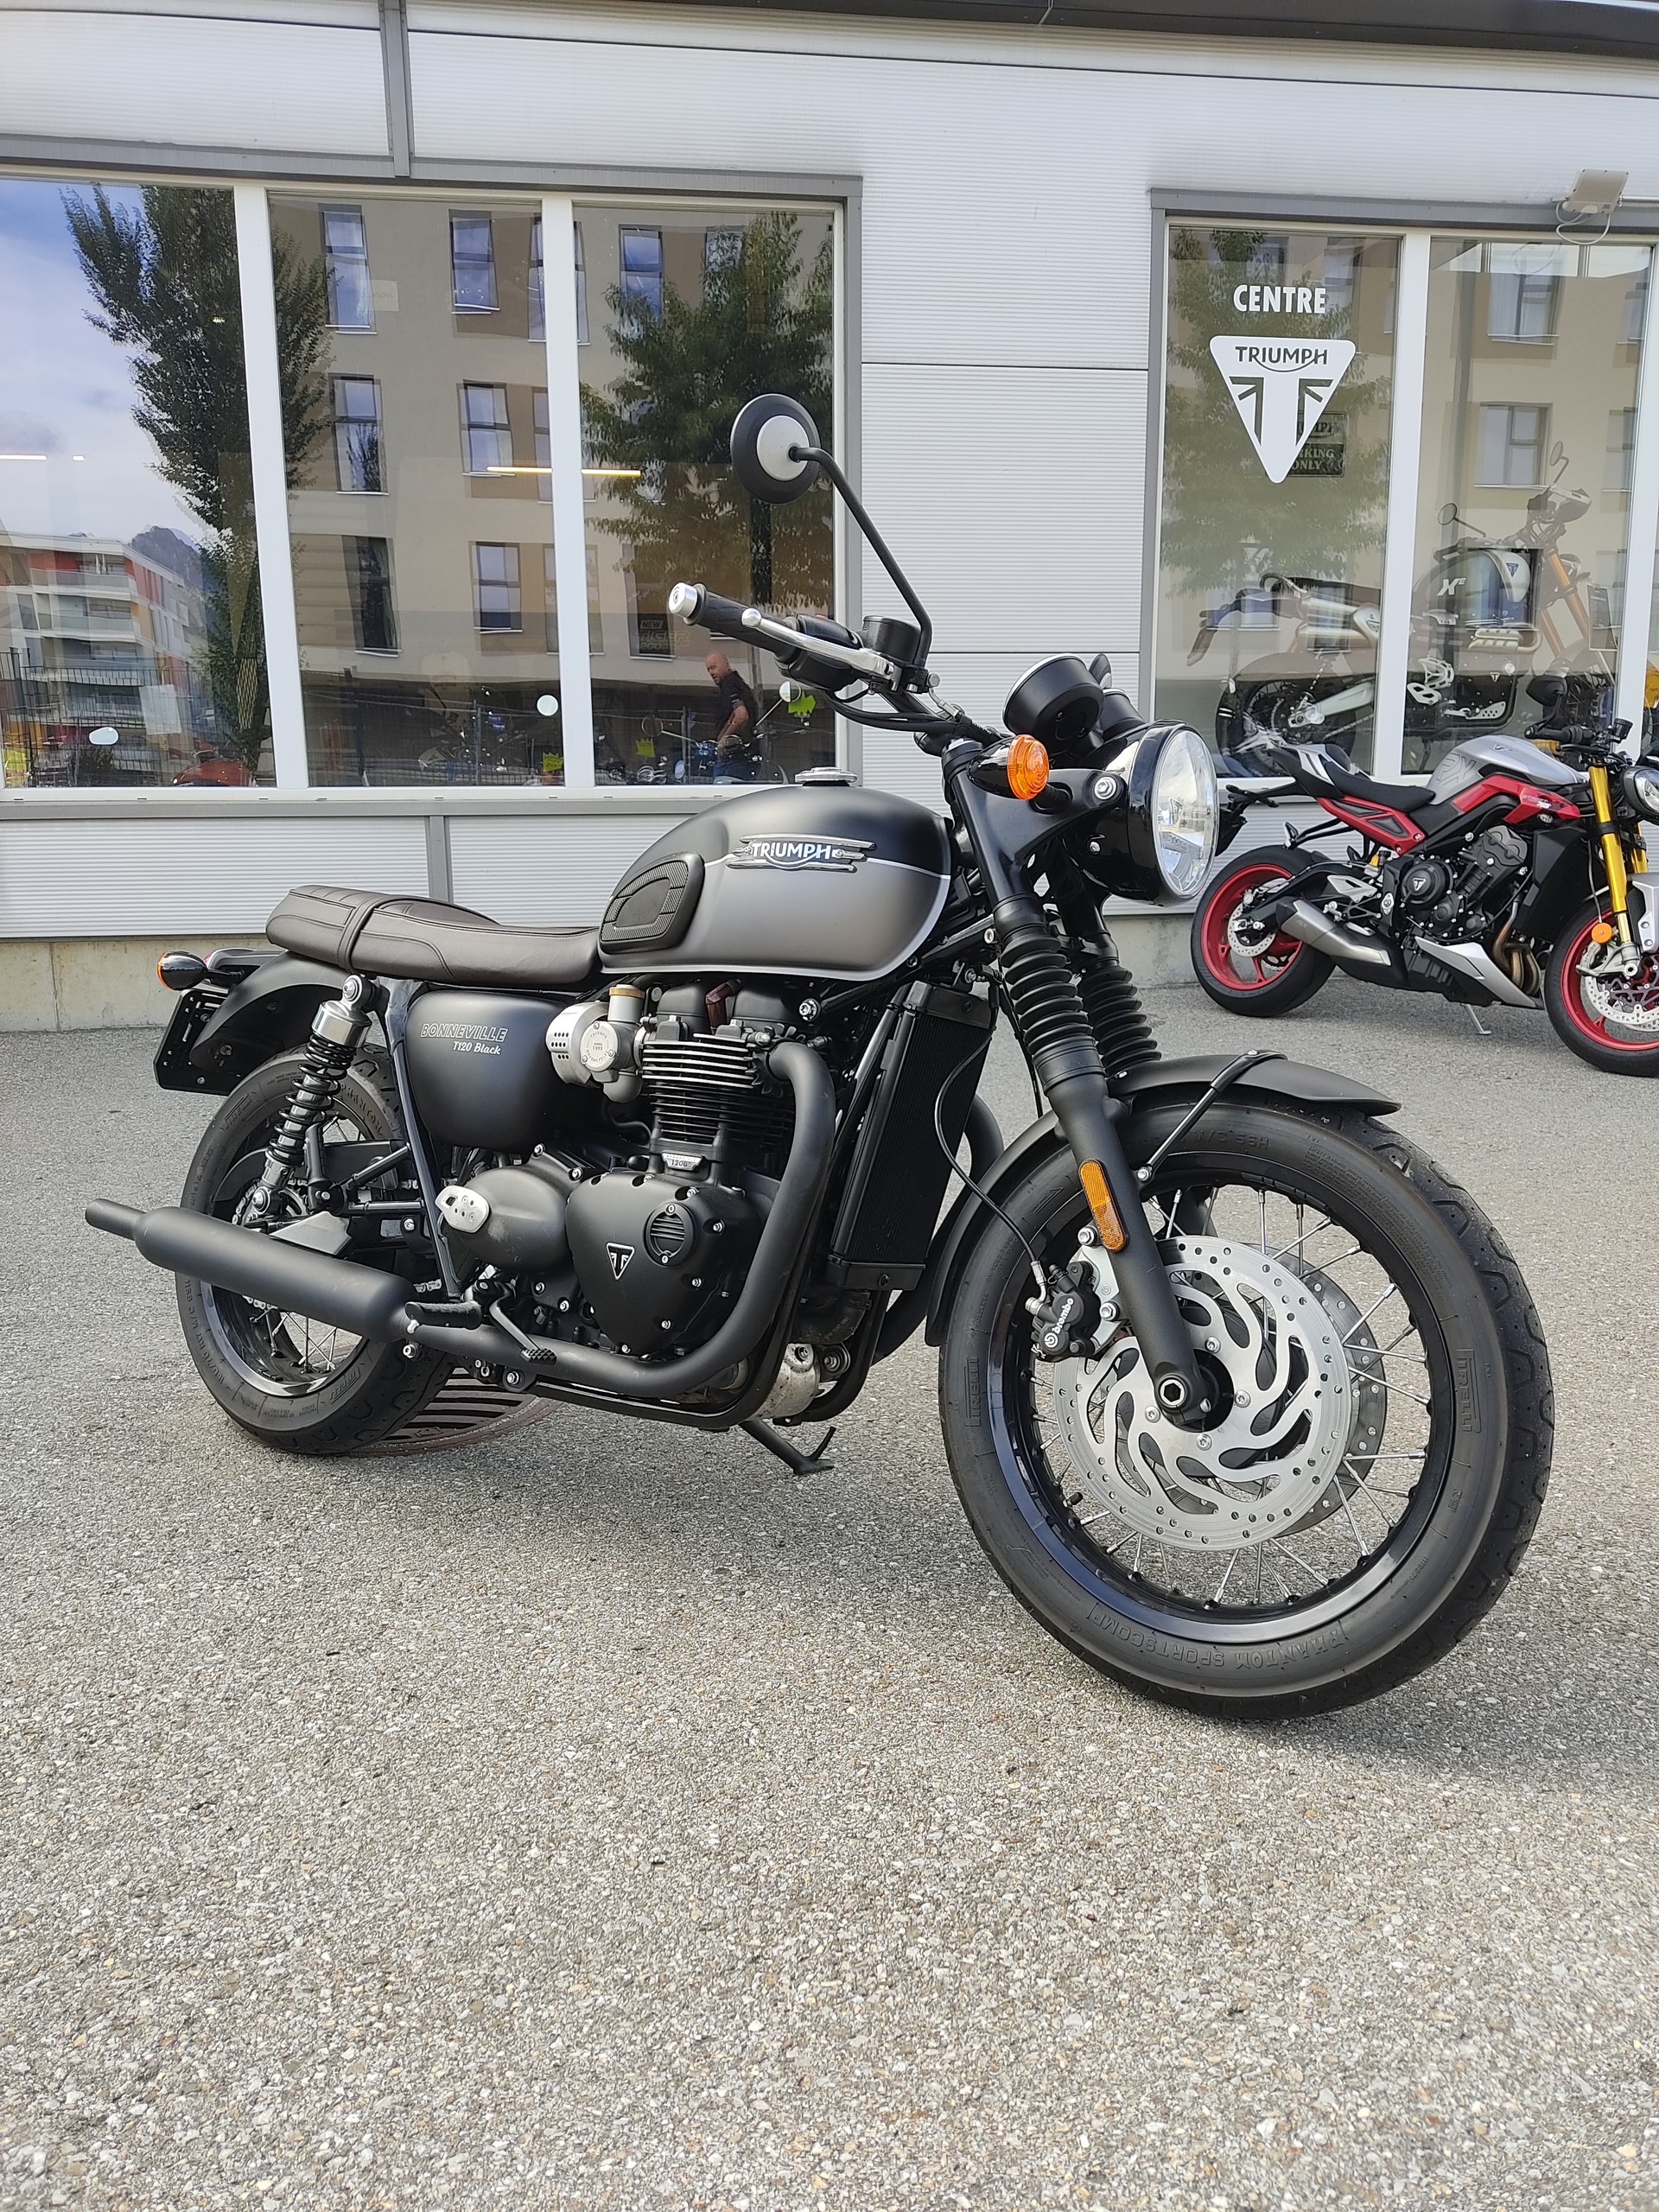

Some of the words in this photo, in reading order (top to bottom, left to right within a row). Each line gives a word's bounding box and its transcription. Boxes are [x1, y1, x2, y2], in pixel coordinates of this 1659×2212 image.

[1233, 284, 1327, 314] CENTRE
[1235, 346, 1328, 372] TRIUMPH
[1299, 448, 1335, 458] RKING
[635, 629, 691, 642] TIGER
[643, 620, 662, 629] NEW
[752, 842, 832, 865] TRIUMPH
[420, 1023, 508, 1042] BONNEVILLE
[453, 1040, 473, 1052] T120
[474, 1042, 502, 1055] Black
[1052, 1298, 1074, 1334] brembo
[964, 1357, 982, 1427] PIRELLI
[1455, 1348, 1482, 1433] PIRELLI
[1091, 1614, 1225, 1668] SPORTSCOMP
[1235, 1630, 1344, 1669] PHANTOM
